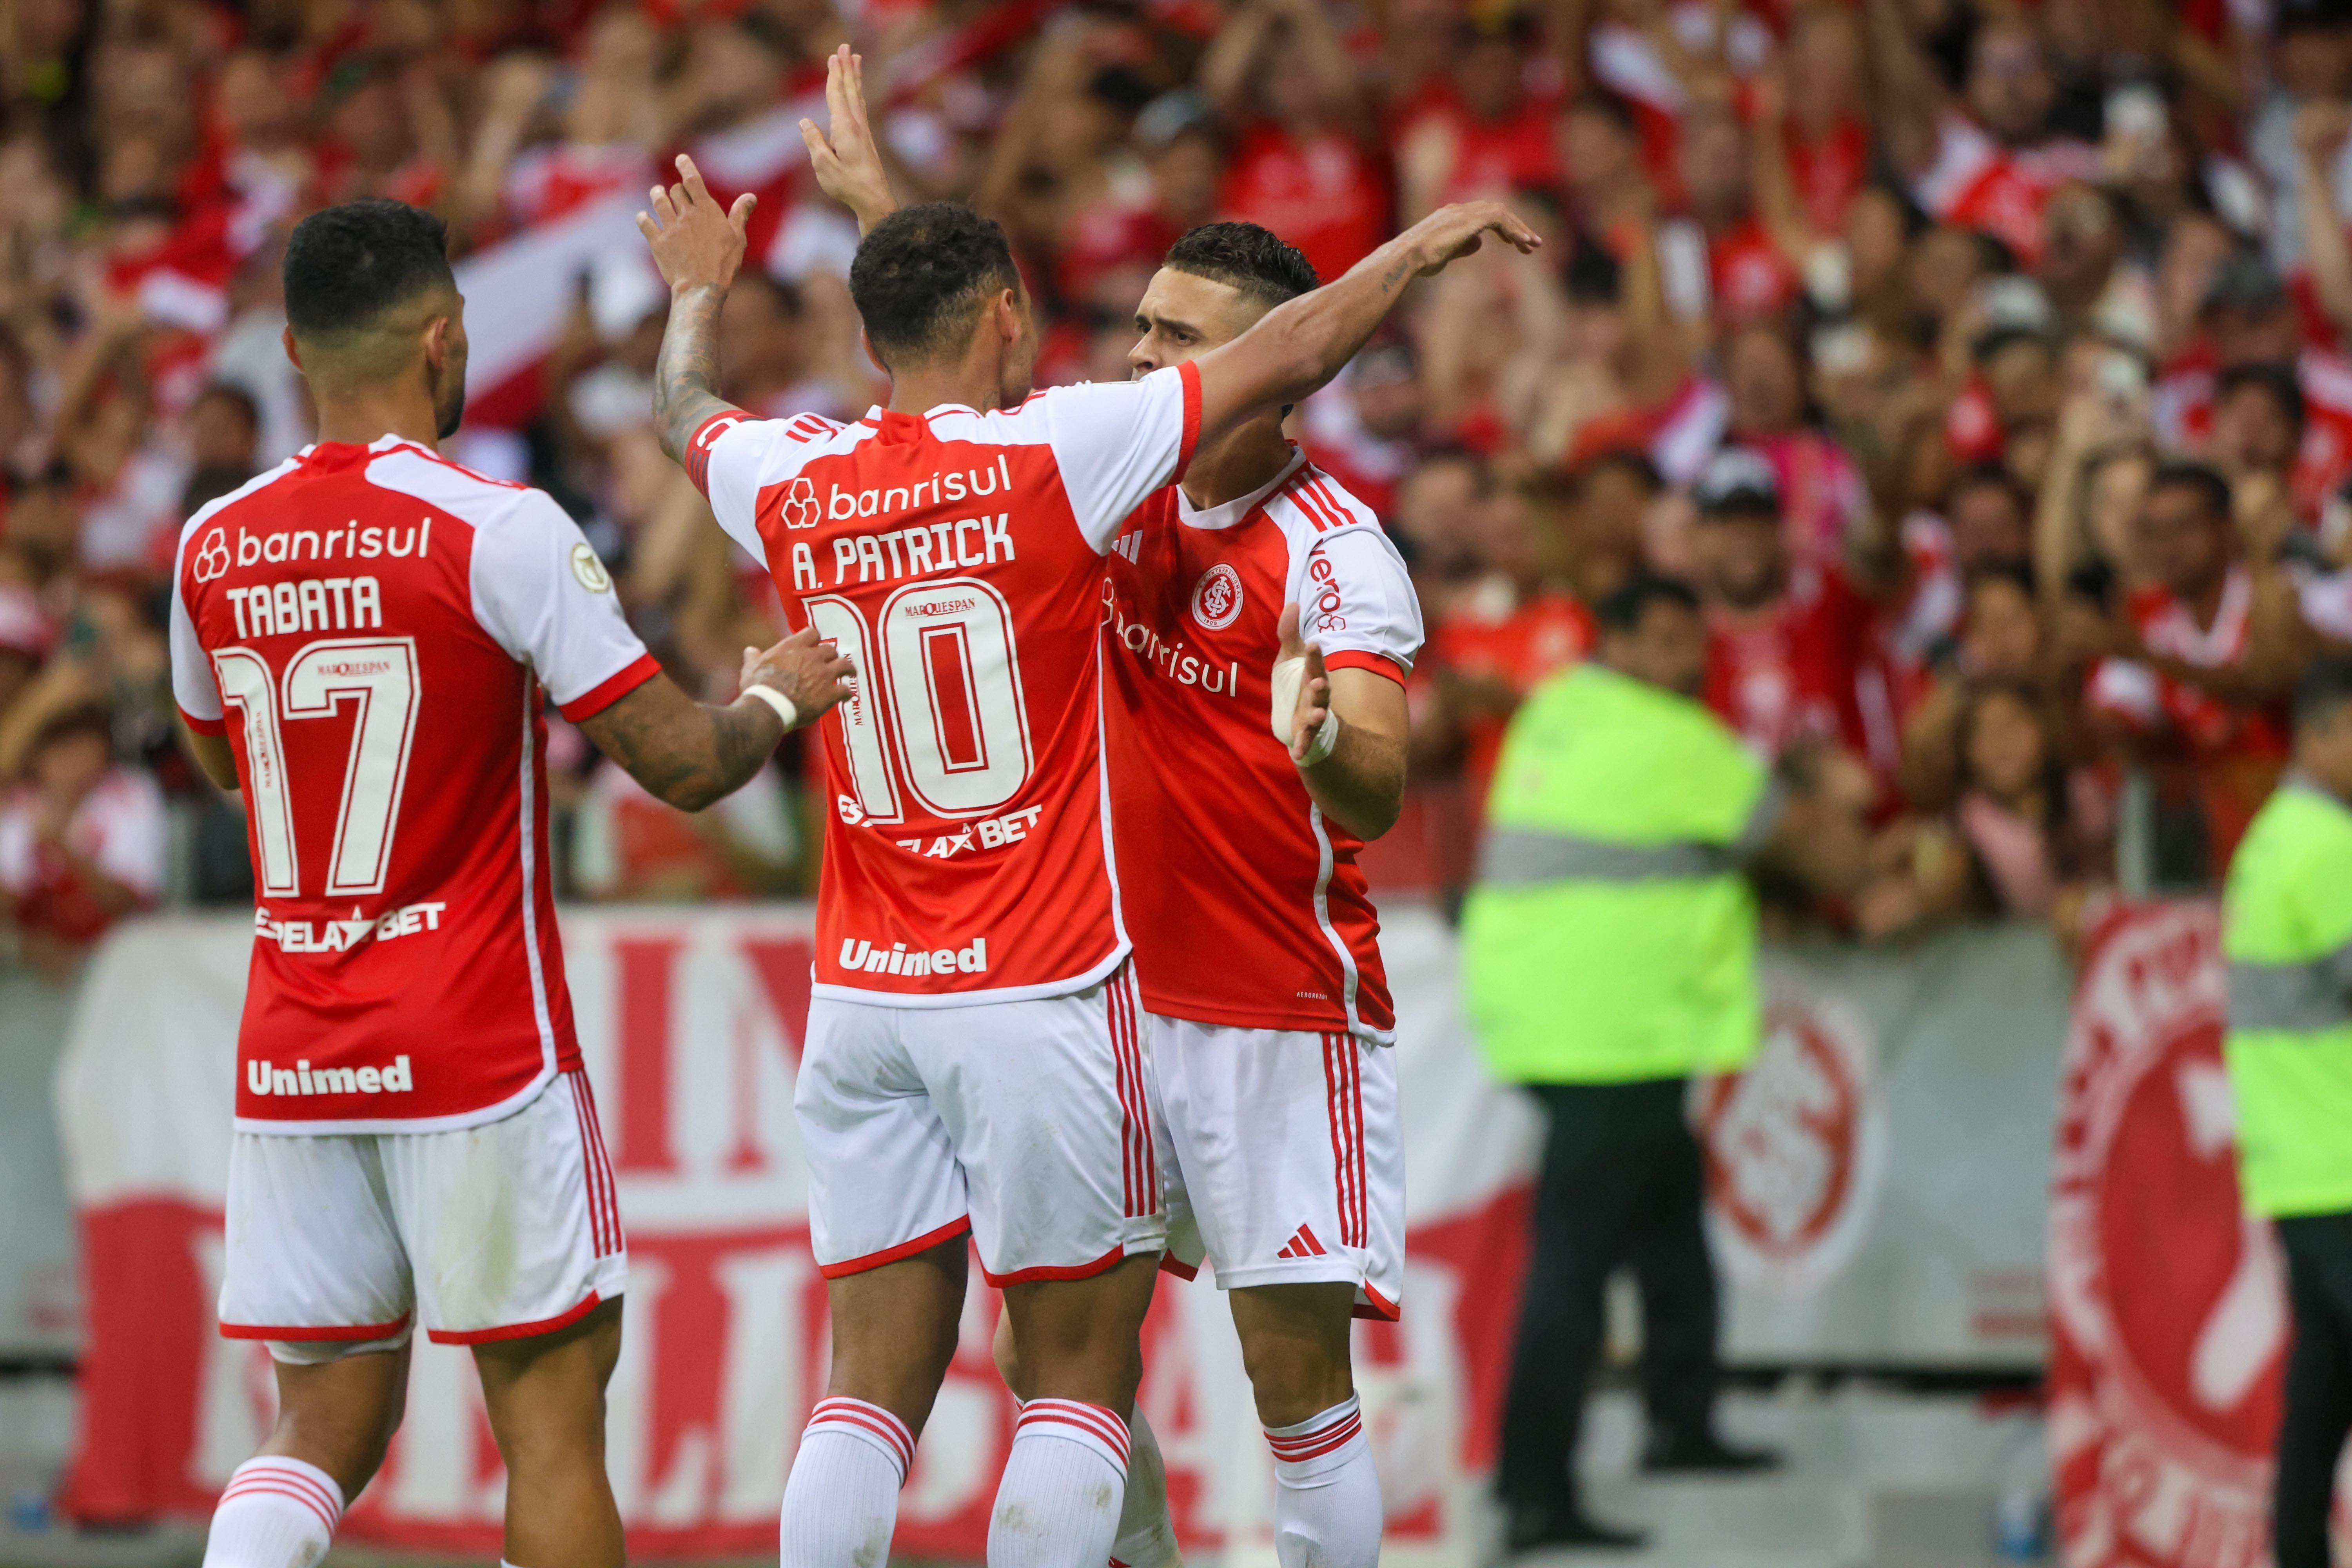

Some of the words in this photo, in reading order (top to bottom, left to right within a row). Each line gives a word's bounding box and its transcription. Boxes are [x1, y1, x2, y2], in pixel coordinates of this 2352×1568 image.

[828, 454, 1011, 521] banrisul
[237, 517, 431, 567] banrisul
[792, 542, 823, 590] A.
[833, 513, 1015, 584] PATRICK
[226, 576, 382, 639] TABATA
[905, 598, 976, 618] MARQUESPAN
[801, 576, 1034, 825] 10
[844, 653, 864, 726] MARQUESN
[210, 636, 421, 898] 17
[838, 937, 987, 976] Unimed
[1296, 991, 1328, 1000] AEROREADY
[247, 1055, 412, 1096] Unimed
